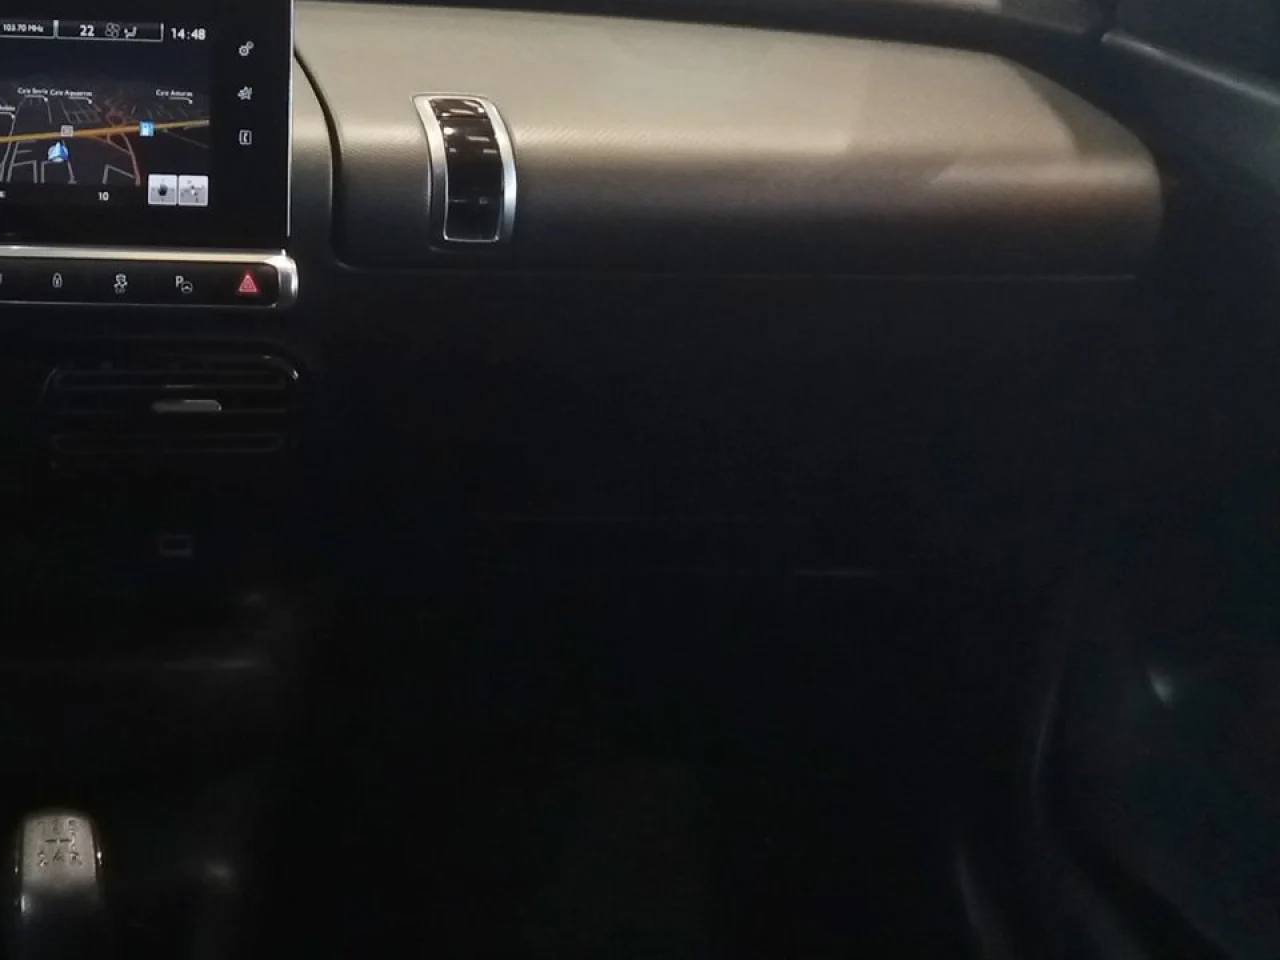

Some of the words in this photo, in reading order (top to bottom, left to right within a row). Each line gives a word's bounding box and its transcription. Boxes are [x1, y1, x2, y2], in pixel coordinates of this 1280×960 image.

[80, 24, 95, 37] 22
[171, 28, 206, 40] 14:48
[98, 193, 109, 201] 10
